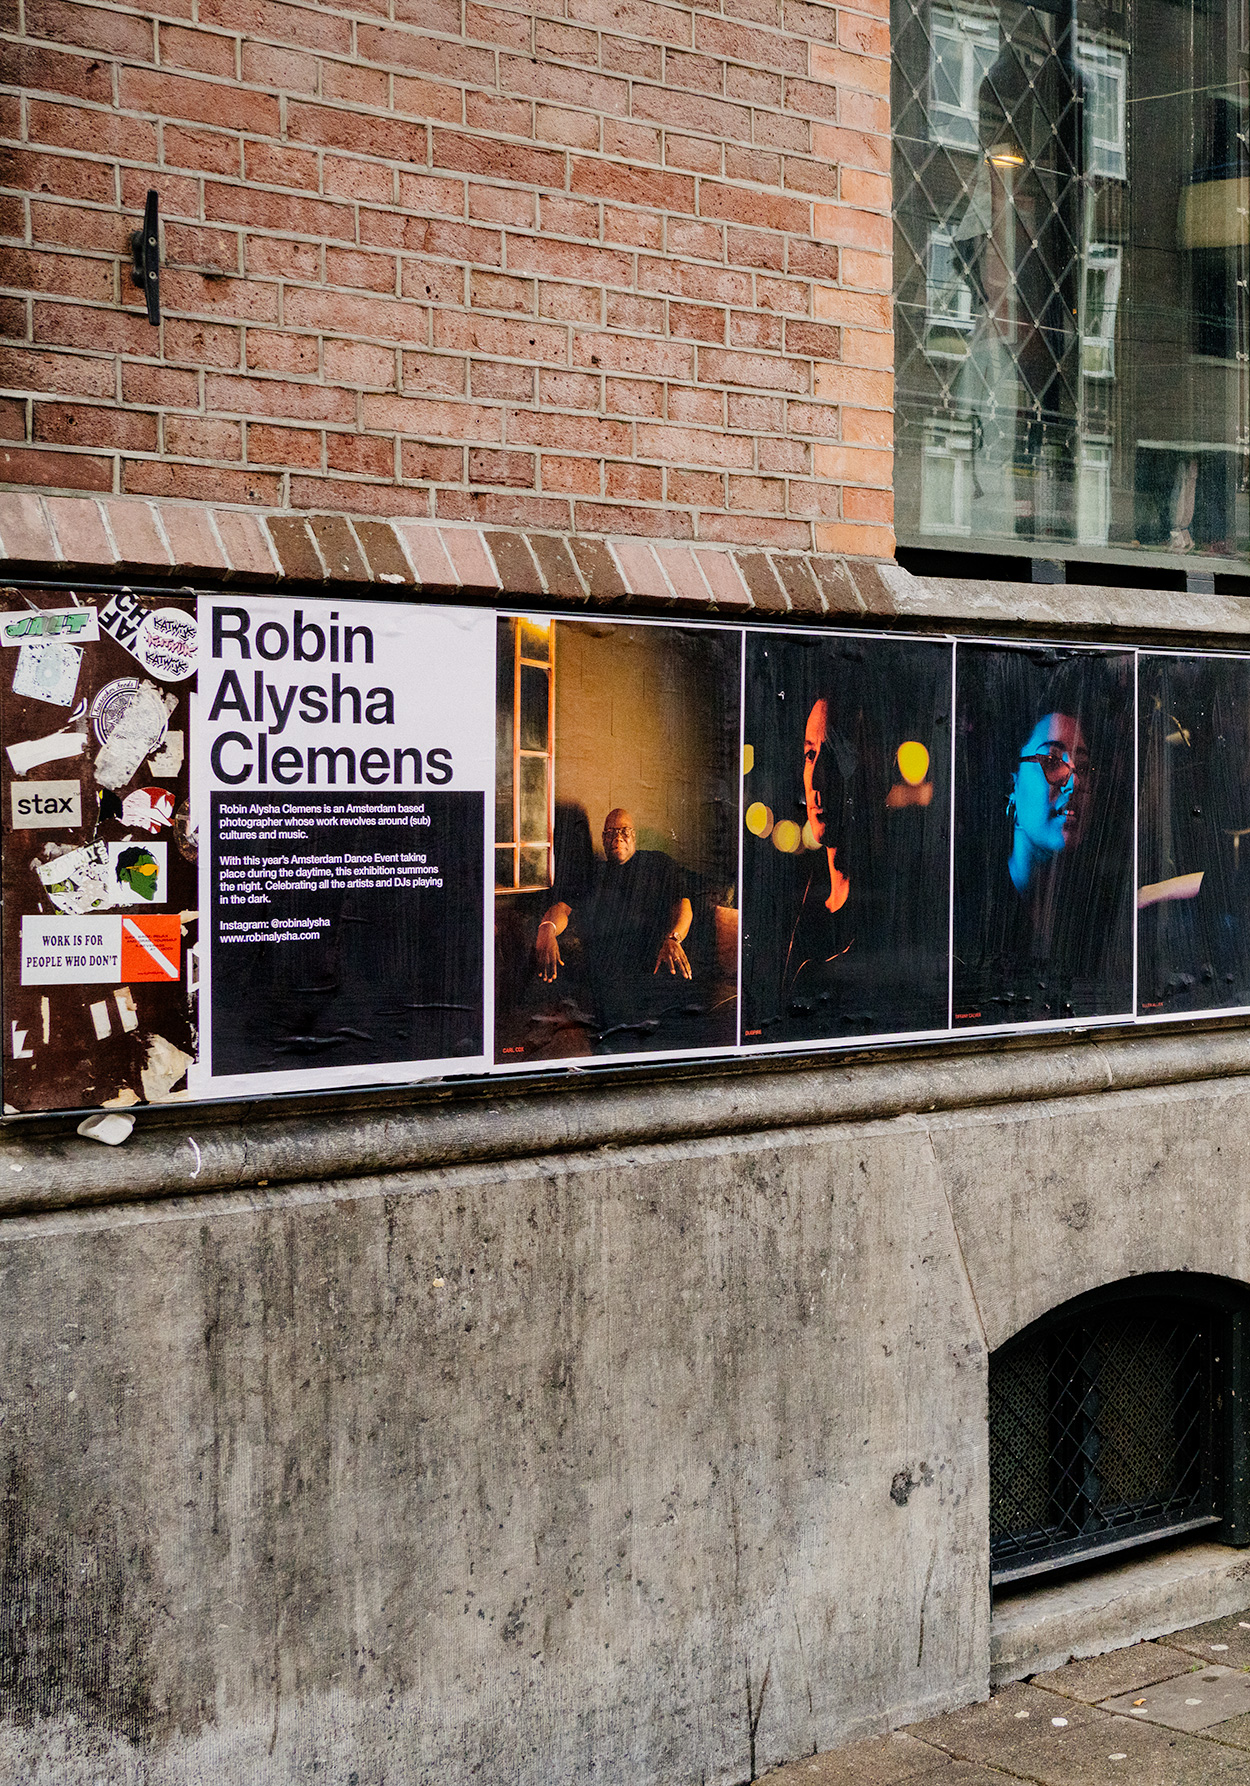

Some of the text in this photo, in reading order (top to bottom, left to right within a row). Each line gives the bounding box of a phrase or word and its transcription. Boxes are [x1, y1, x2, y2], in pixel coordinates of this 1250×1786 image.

[212, 605, 374, 663] Robin
[207, 668, 396, 735] Alysha
[210, 730, 454, 786] Clemens
[17, 794, 74, 815] stax
[219, 803, 425, 816] Robin Alysha Clemens is an Amsterdam based
[219, 815, 431, 830] photographer whose work revolves around (sub)
[219, 829, 309, 840] cultures and music.
[219, 852, 427, 868] With this year's Amsterdam Dance Event taking
[219, 865, 439, 881] place during the daytime, this exhibition summons
[219, 876, 444, 894] the night. Celebrating all the artists and DJs playing
[219, 893, 272, 905] in the dark.
[219, 916, 331, 932] Instagram: @robinalysha
[42, 934, 104, 947] WORK IS FOR
[219, 929, 320, 944] www.robinalysha.com
[26, 954, 118, 968] PEOPLE WHO DON'T
